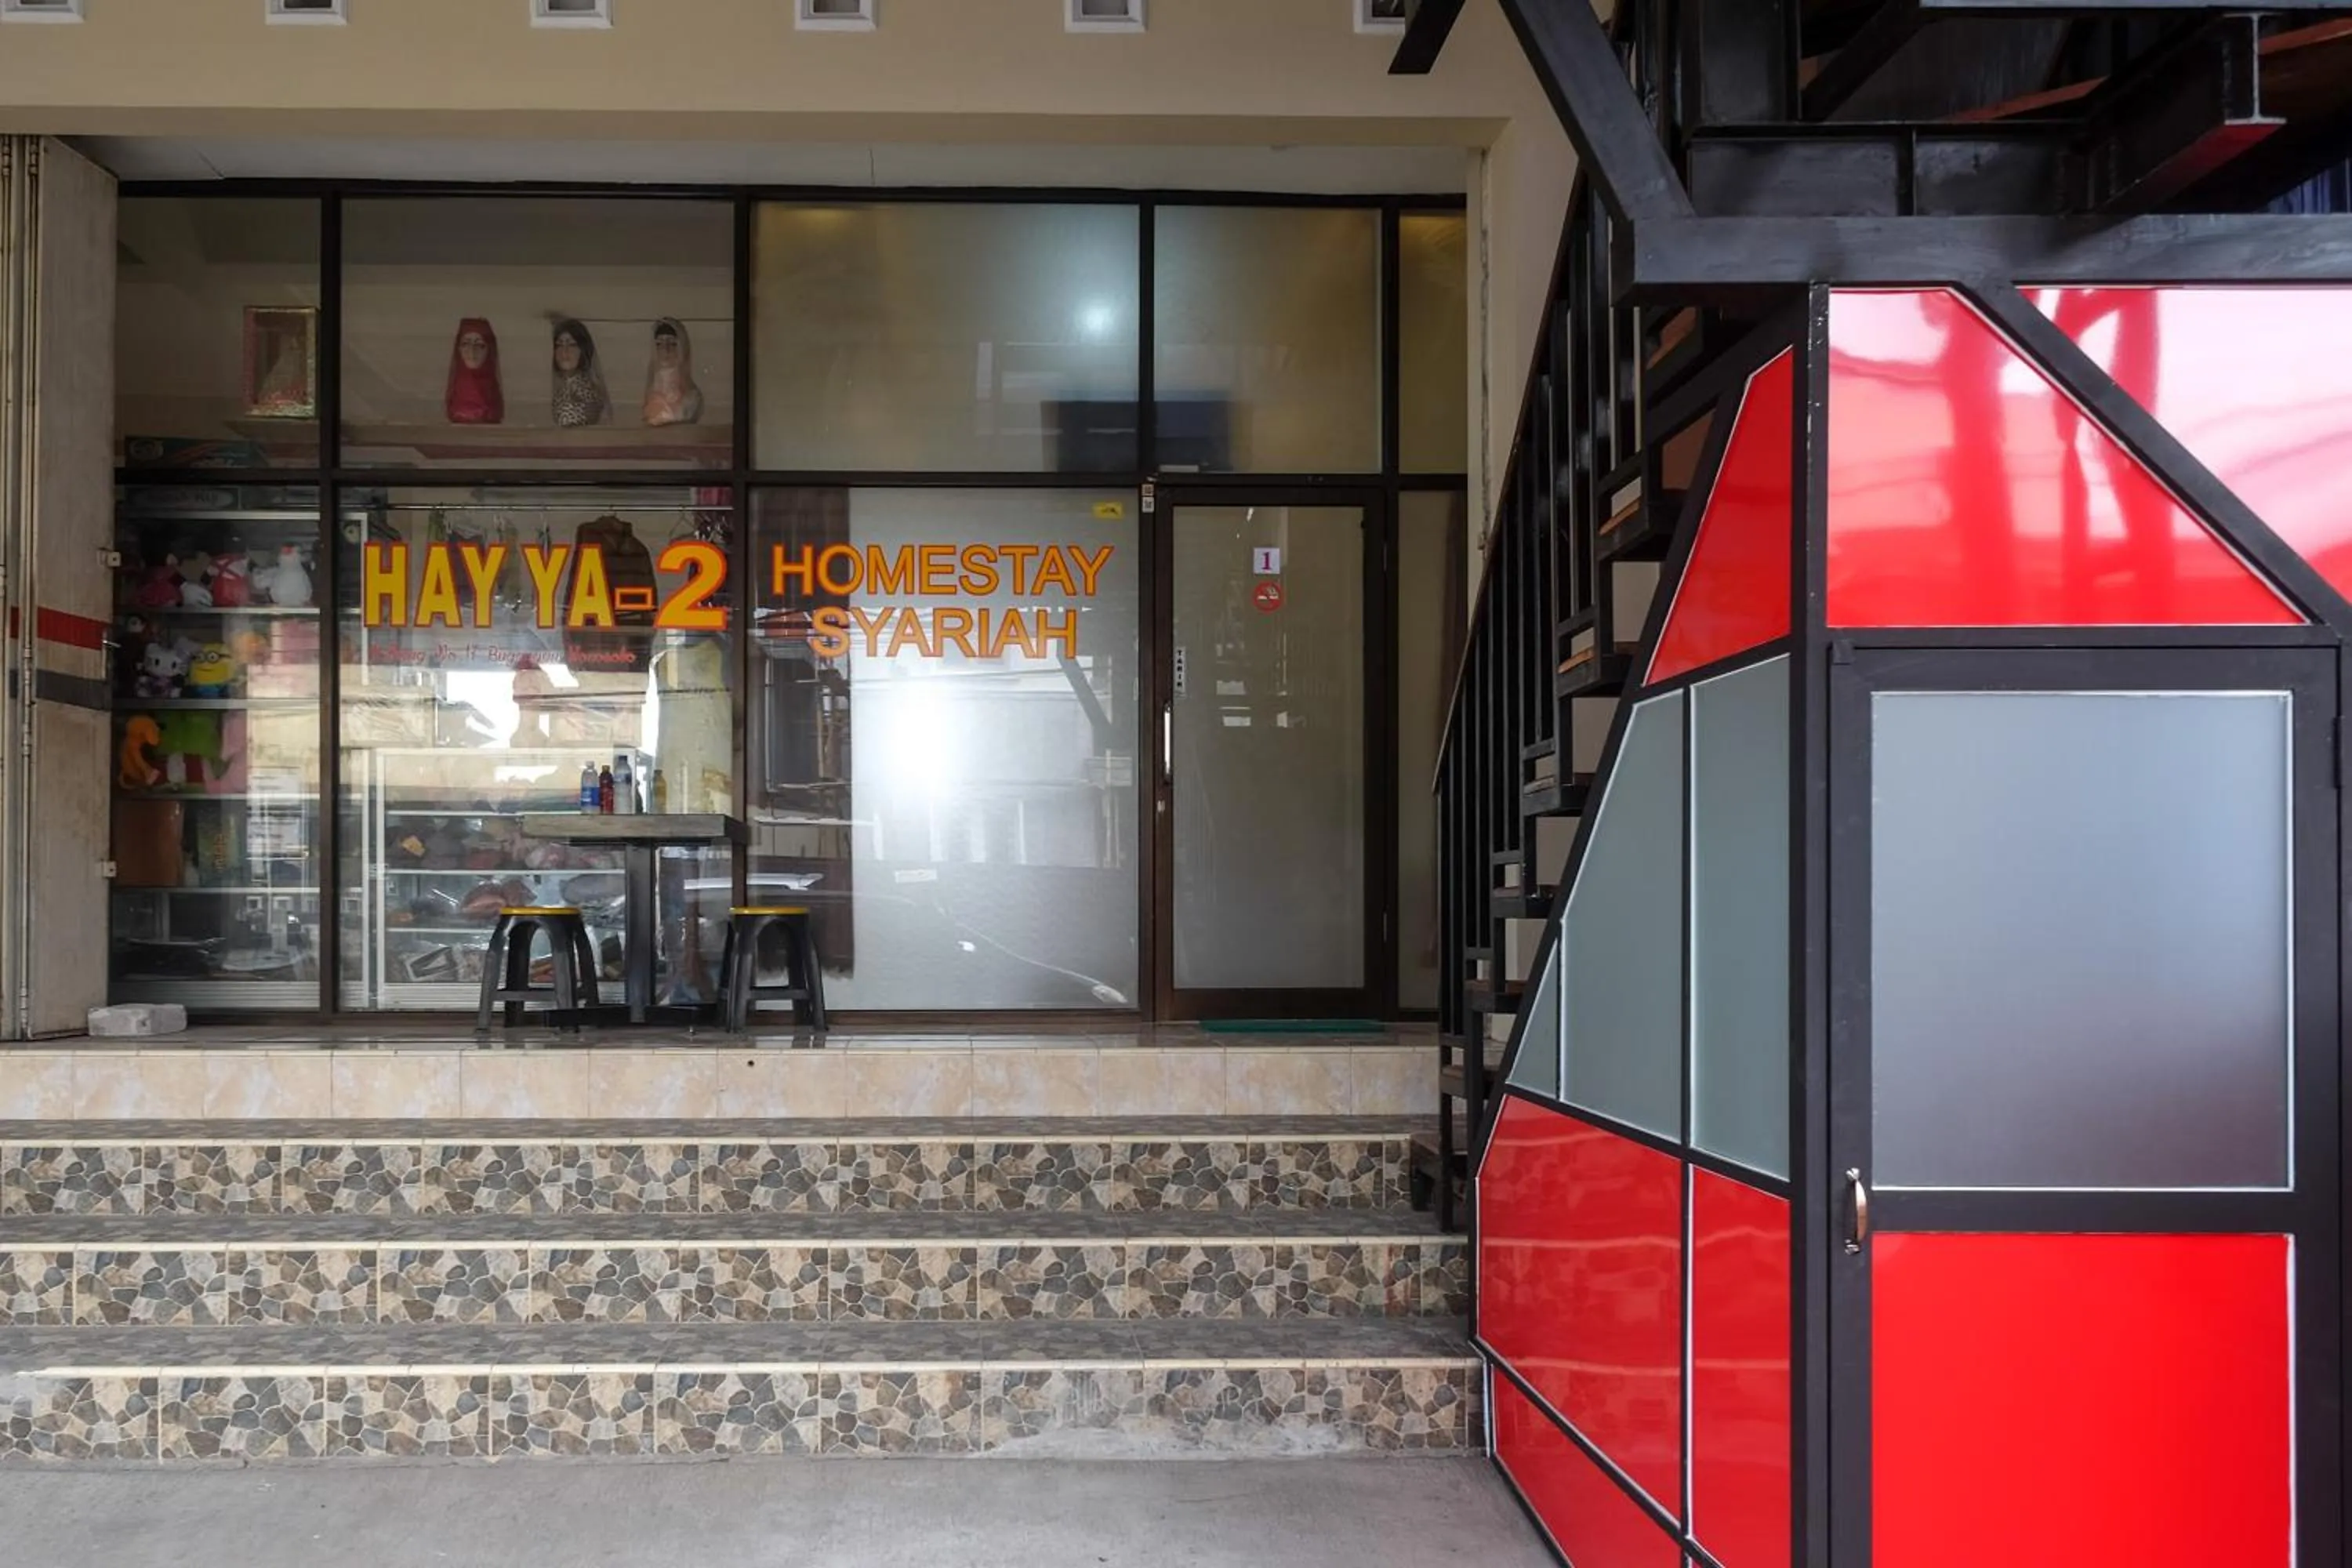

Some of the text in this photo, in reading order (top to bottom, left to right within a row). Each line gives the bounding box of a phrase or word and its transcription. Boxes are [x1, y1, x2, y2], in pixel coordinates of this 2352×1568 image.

[363, 542, 506, 628] HAY
[771, 544, 1113, 596] HOMESTAY
[1261, 552, 1272, 570] 1
[810, 606, 1077, 659] SYARIAH
